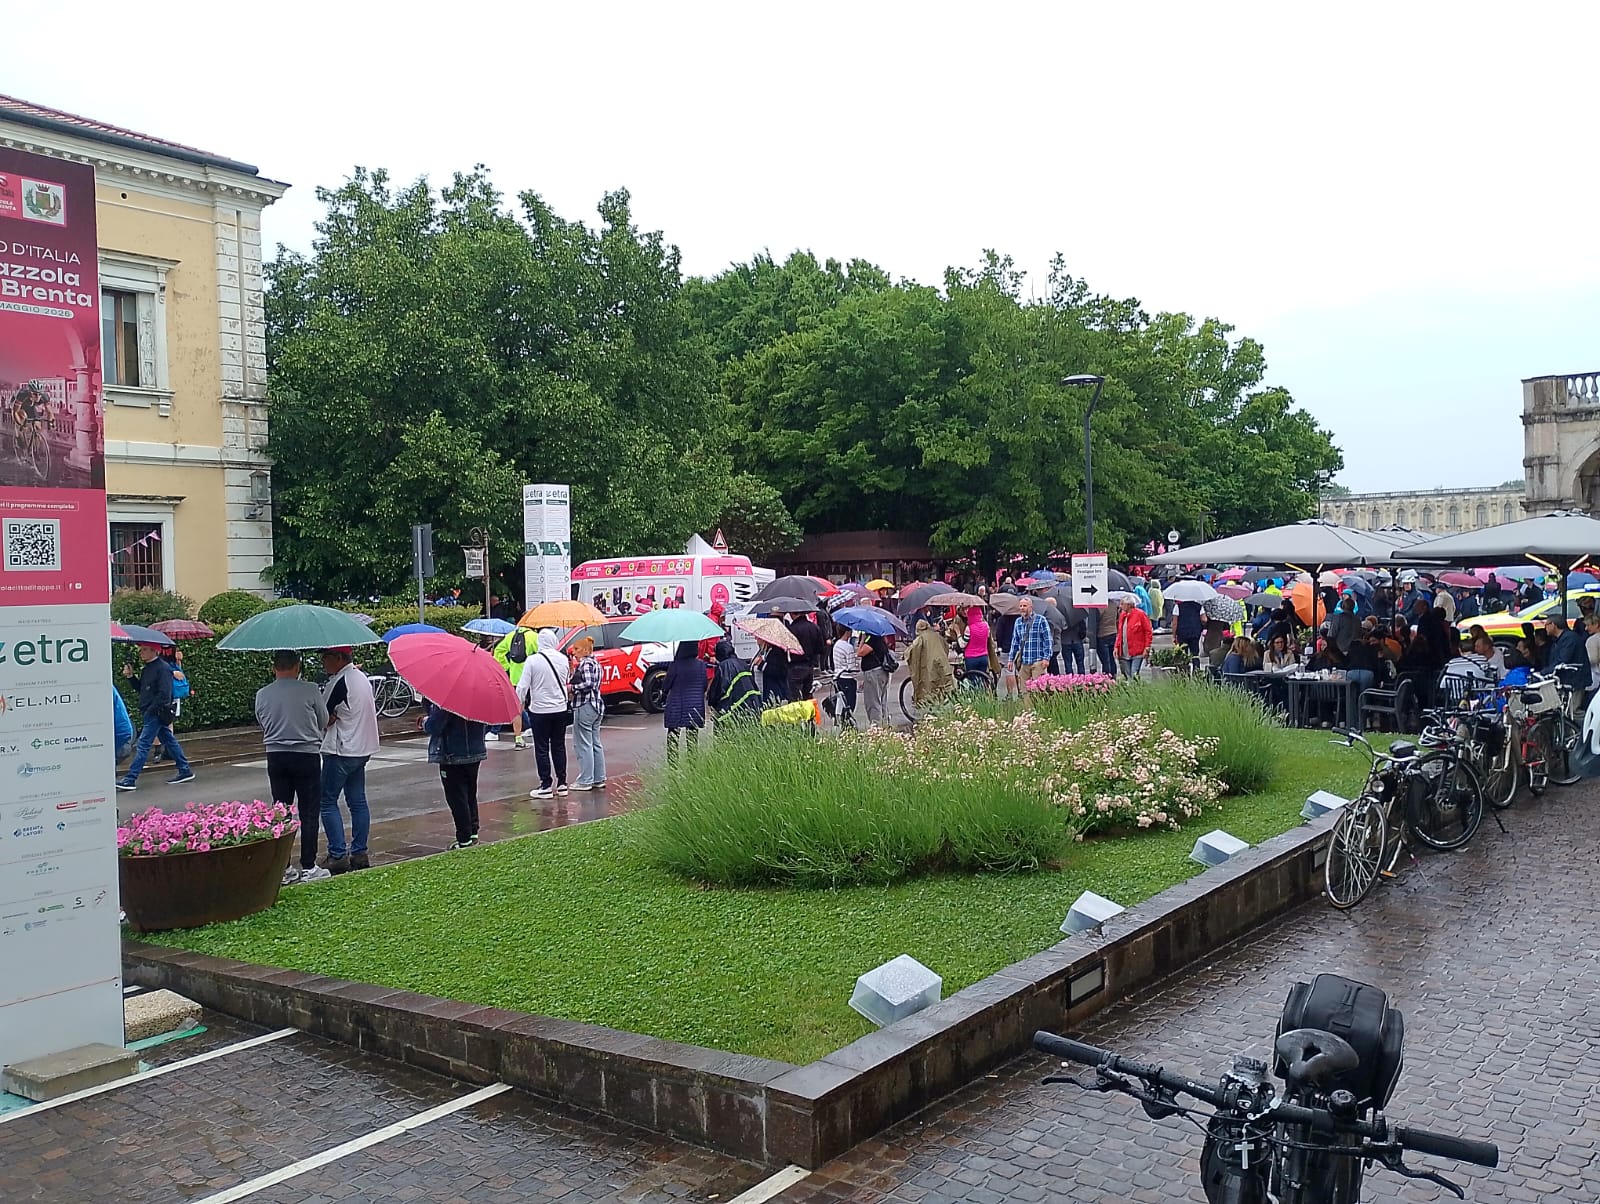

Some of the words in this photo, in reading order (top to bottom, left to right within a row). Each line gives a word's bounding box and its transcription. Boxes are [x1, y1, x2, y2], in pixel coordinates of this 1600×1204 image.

[12, 242, 81, 265] D'ITALIA
[1, 278, 92, 307] Brenta
[13, 634, 89, 666] etra
[64, 736, 88, 744] ROMA
